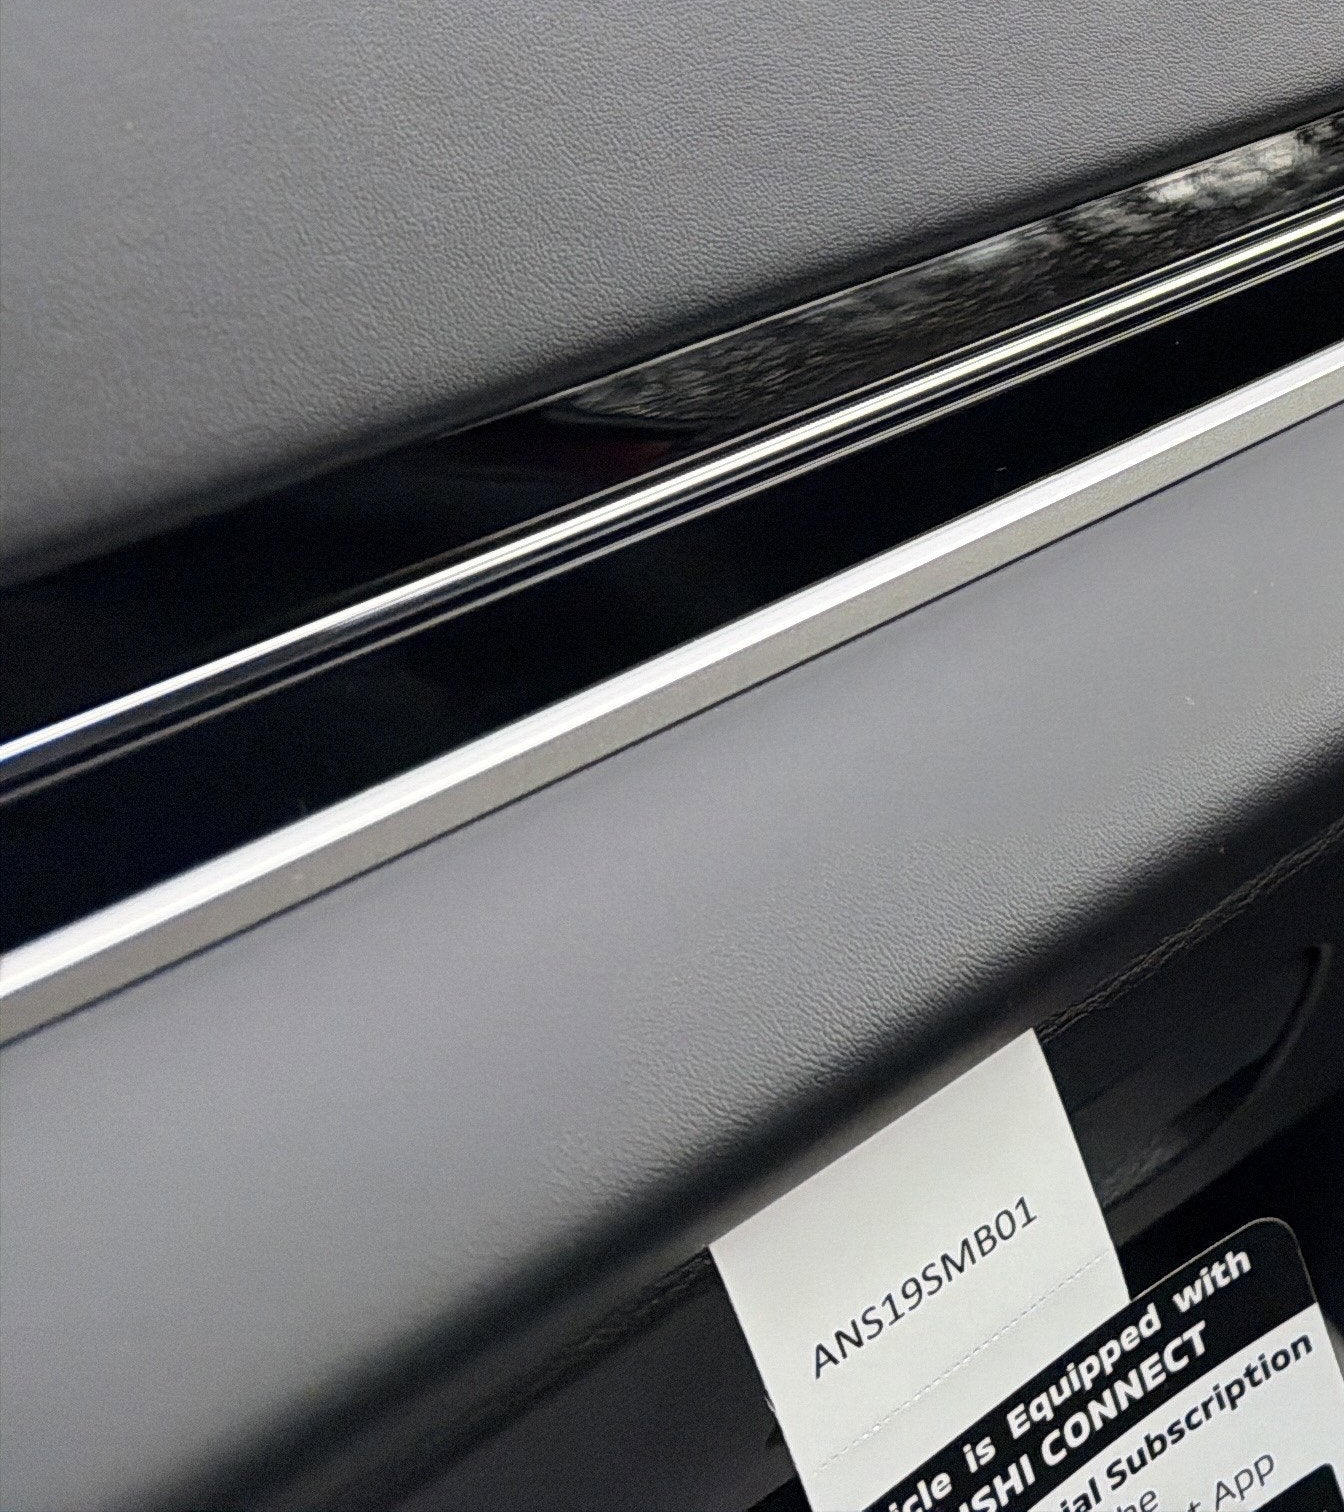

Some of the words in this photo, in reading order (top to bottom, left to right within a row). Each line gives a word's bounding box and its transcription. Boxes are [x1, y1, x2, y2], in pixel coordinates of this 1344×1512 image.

[813, 1195, 1039, 1382] ANS19SMB01
[962, 1435, 997, 1473] is
[1005, 1301, 1162, 1440] Equipped
[1171, 1248, 1252, 1314] with
[1040, 1319, 1208, 1468] CONNECT
[1105, 1333, 1315, 1492] Subscription
[1215, 1453, 1275, 1512] App
